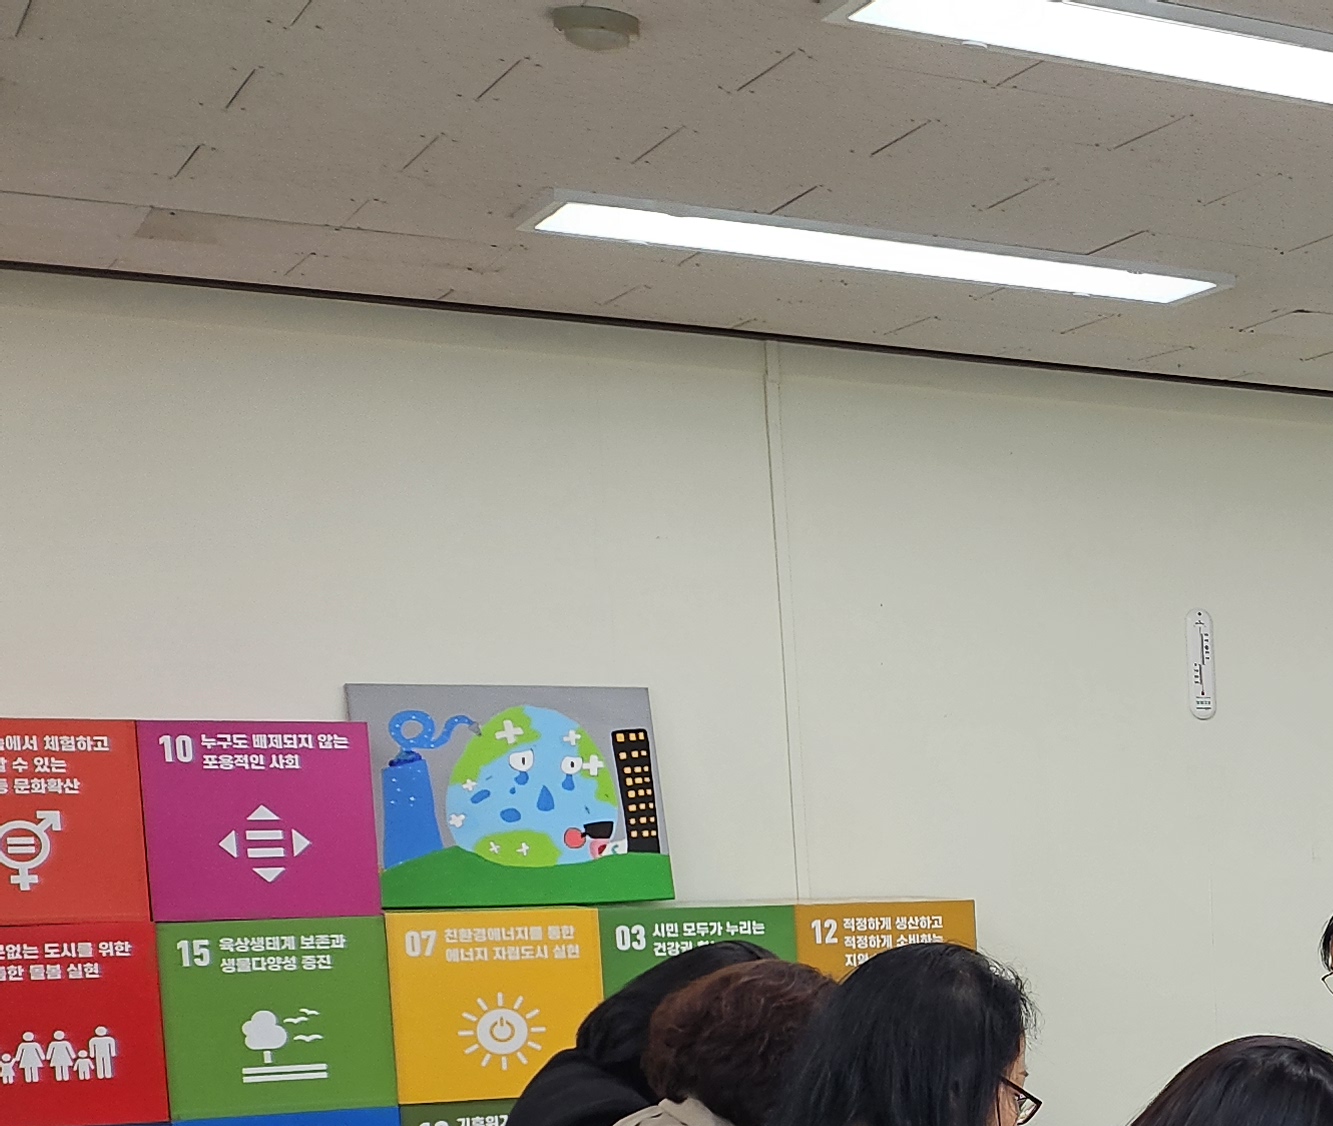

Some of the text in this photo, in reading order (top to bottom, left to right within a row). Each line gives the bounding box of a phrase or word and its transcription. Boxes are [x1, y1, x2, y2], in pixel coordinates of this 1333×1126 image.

[0, 735, 110, 752] 에서 체험하고
[158, 734, 194, 763] 10
[201, 733, 350, 750] 누구도 배제되지 않는
[12, 757, 29, 773] 수
[34, 757, 67, 773] 있는
[202, 753, 301, 770] 포용적인 사회
[14, 778, 81, 795] 문화확산
[653, 920, 765, 938] 시민 모두가 누리는
[811, 919, 838, 945] 12
[843, 916, 944, 932] 적정하게 생산하고
[218, 933, 347, 952] 육상생태계 보존과
[404, 930, 438, 957] 07
[615, 925, 647, 951] 03
[843, 934, 894, 950] 적정하게
[98, 940, 133, 957] 위한
[176, 939, 211, 967] 15
[445, 944, 580, 963] 에너지 자립도시 실현
[66, 962, 101, 979] 실현
[219, 954, 333, 974] 생물다양성 증진
